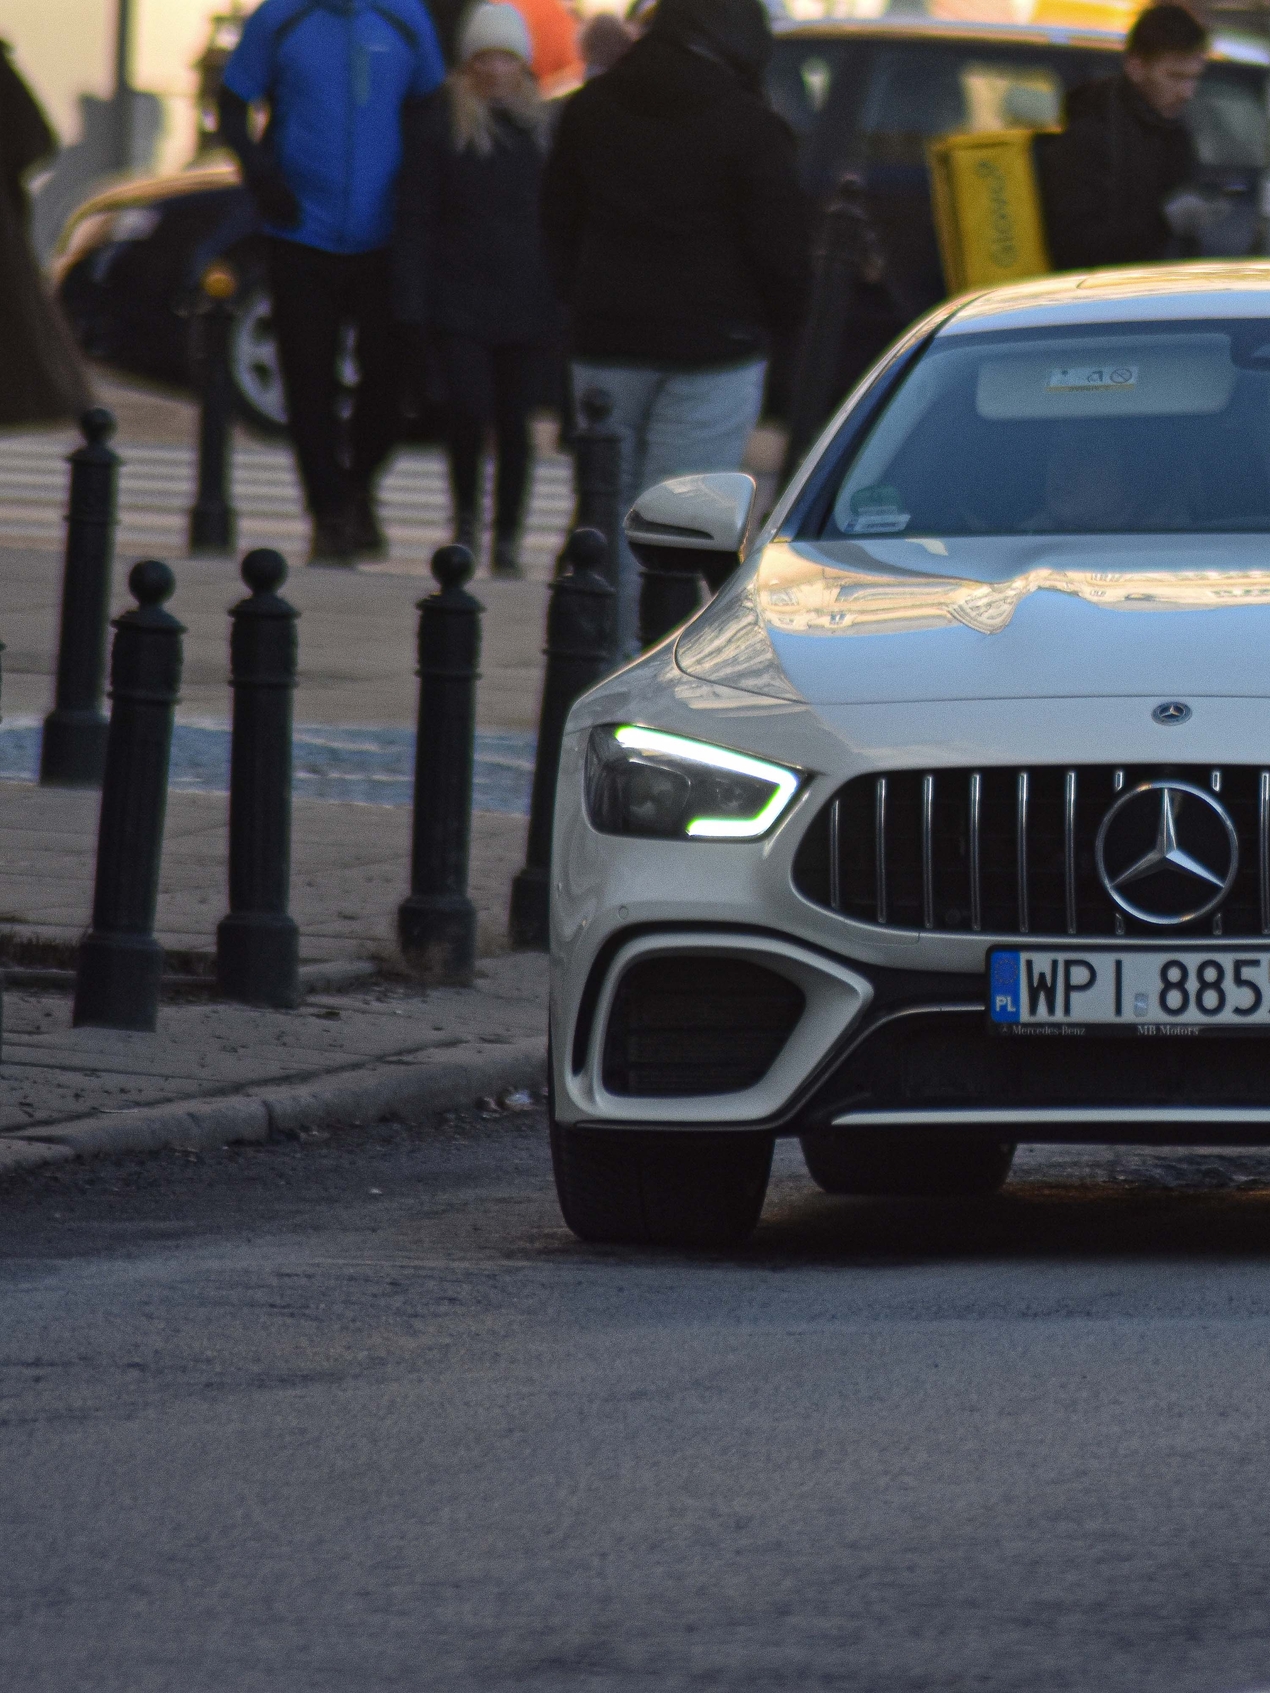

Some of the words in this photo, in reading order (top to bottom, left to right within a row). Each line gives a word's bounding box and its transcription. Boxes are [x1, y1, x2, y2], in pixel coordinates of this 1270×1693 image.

[1025, 959, 1123, 1017] WPI
[995, 996, 1016, 1013] PL
[1012, 1025, 1086, 1036] Mercedes-Benz
[1137, 1025, 1157, 1035] MB
[1160, 1024, 1200, 1036] Motors
